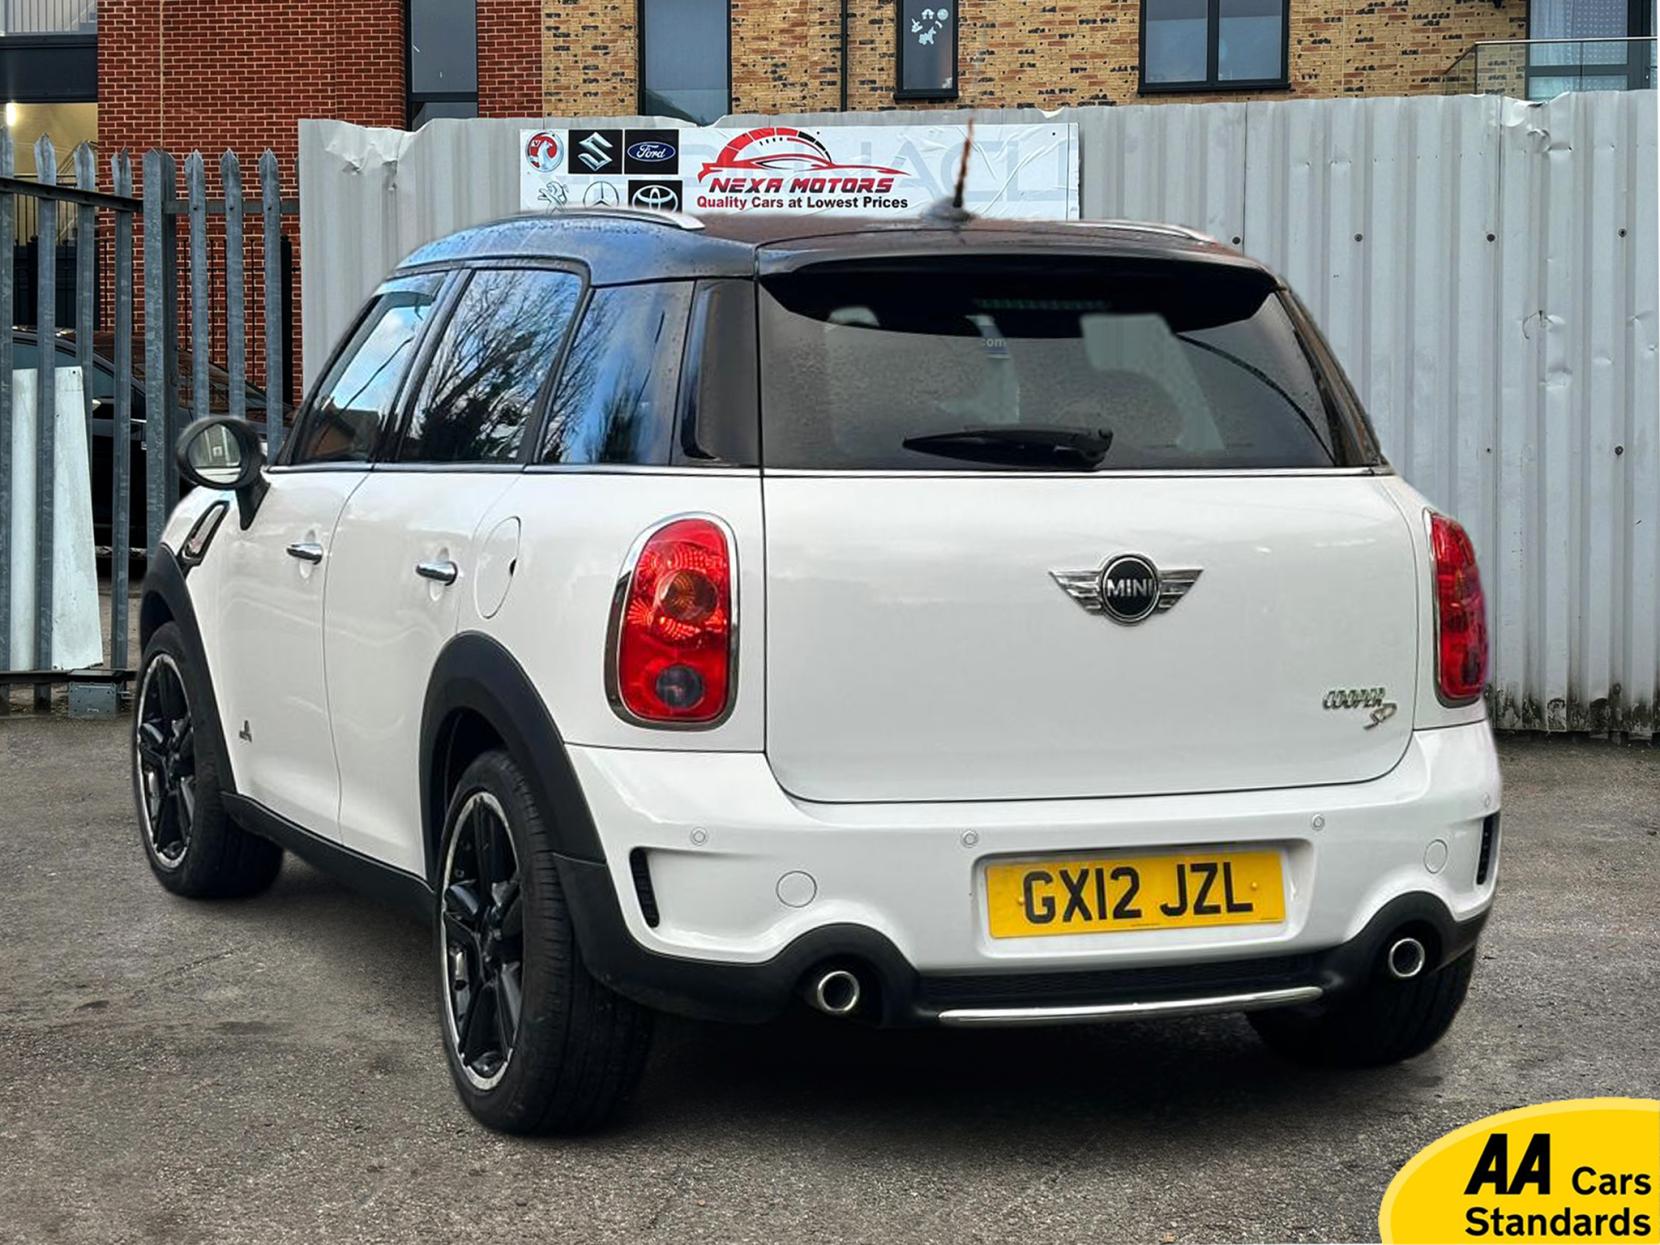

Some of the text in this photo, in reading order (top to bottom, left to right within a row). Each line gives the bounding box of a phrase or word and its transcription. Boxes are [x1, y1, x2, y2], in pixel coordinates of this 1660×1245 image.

[636, 144, 666, 159] Ford
[709, 178, 894, 193] NEXA MOTORS
[697, 195, 908, 210] Quality Cars at Lowest Prices
[1107, 578, 1153, 597] MINI
[1322, 687, 1385, 709] COOPER
[1023, 862, 1253, 924] GX12 JZL
